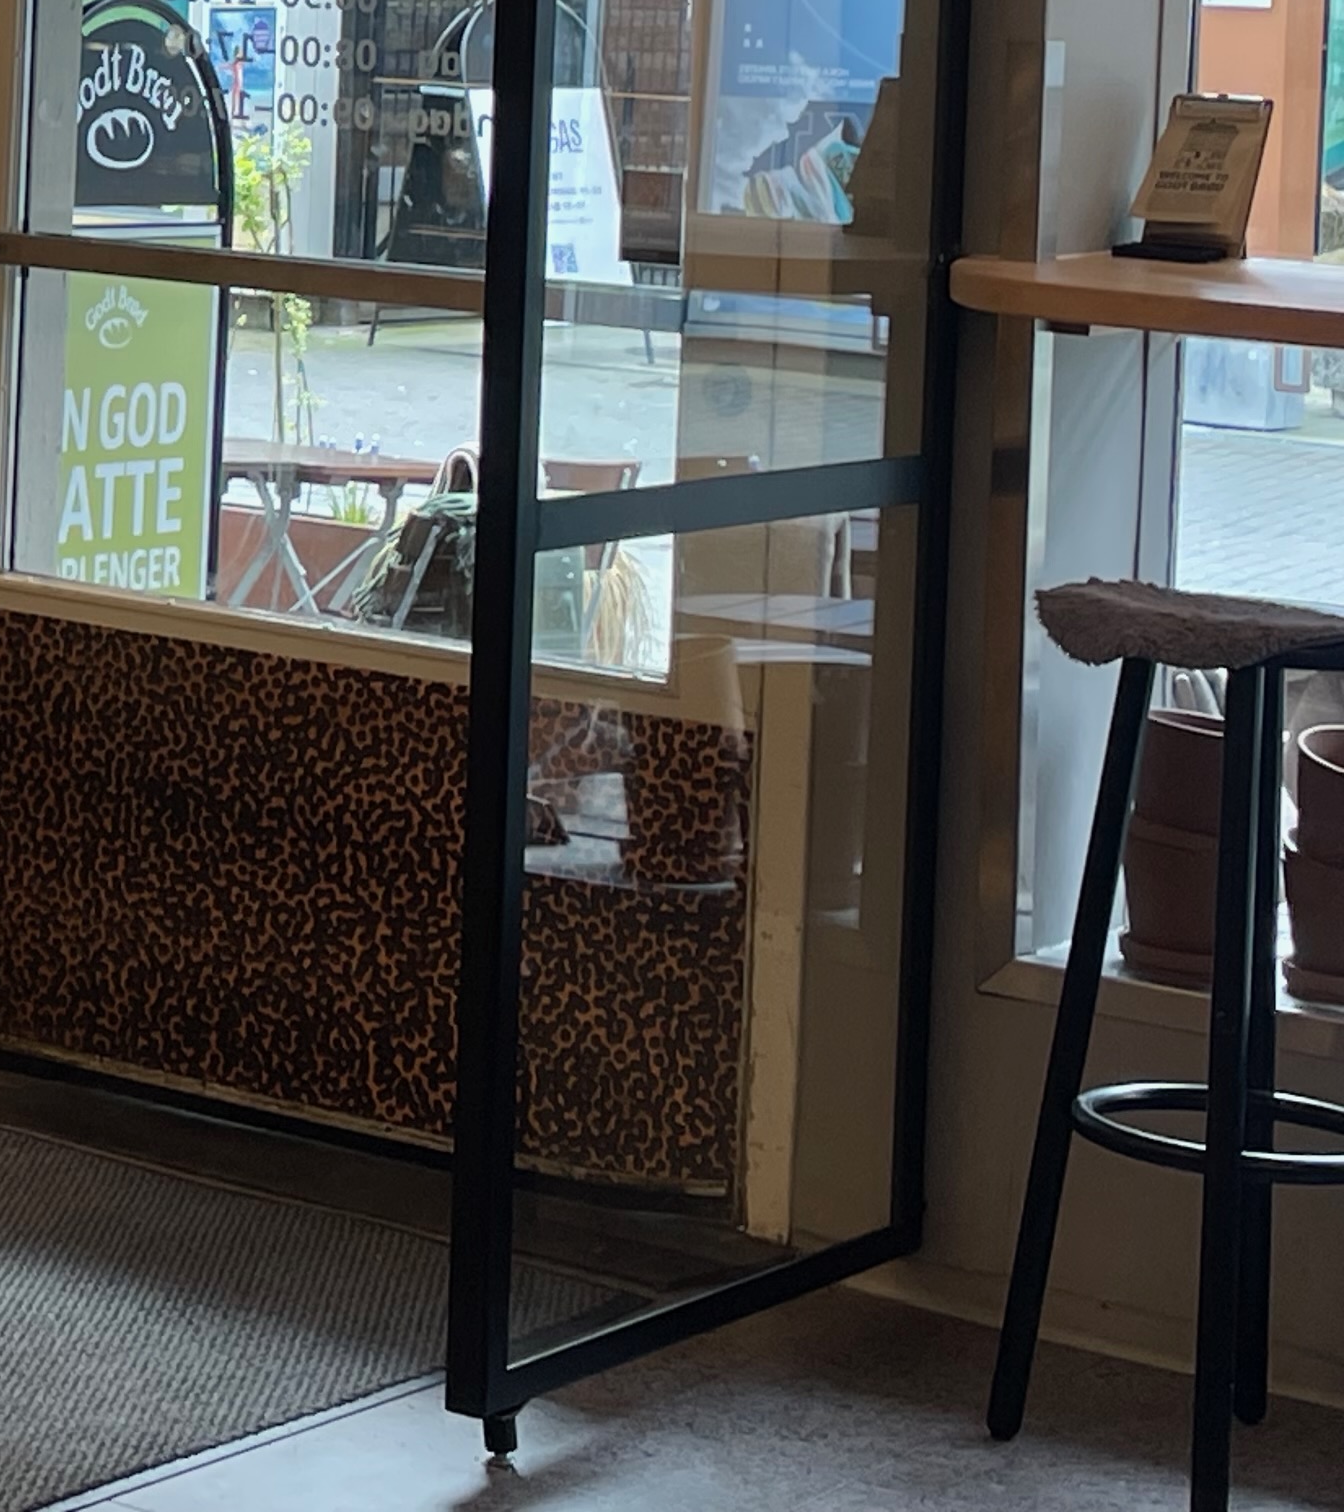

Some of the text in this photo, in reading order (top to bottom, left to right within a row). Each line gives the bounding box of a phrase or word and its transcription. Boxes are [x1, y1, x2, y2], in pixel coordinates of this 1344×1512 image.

[75, 42, 123, 126] odt
[61, 381, 188, 455] N GOD
[56, 456, 185, 544] ATTE
